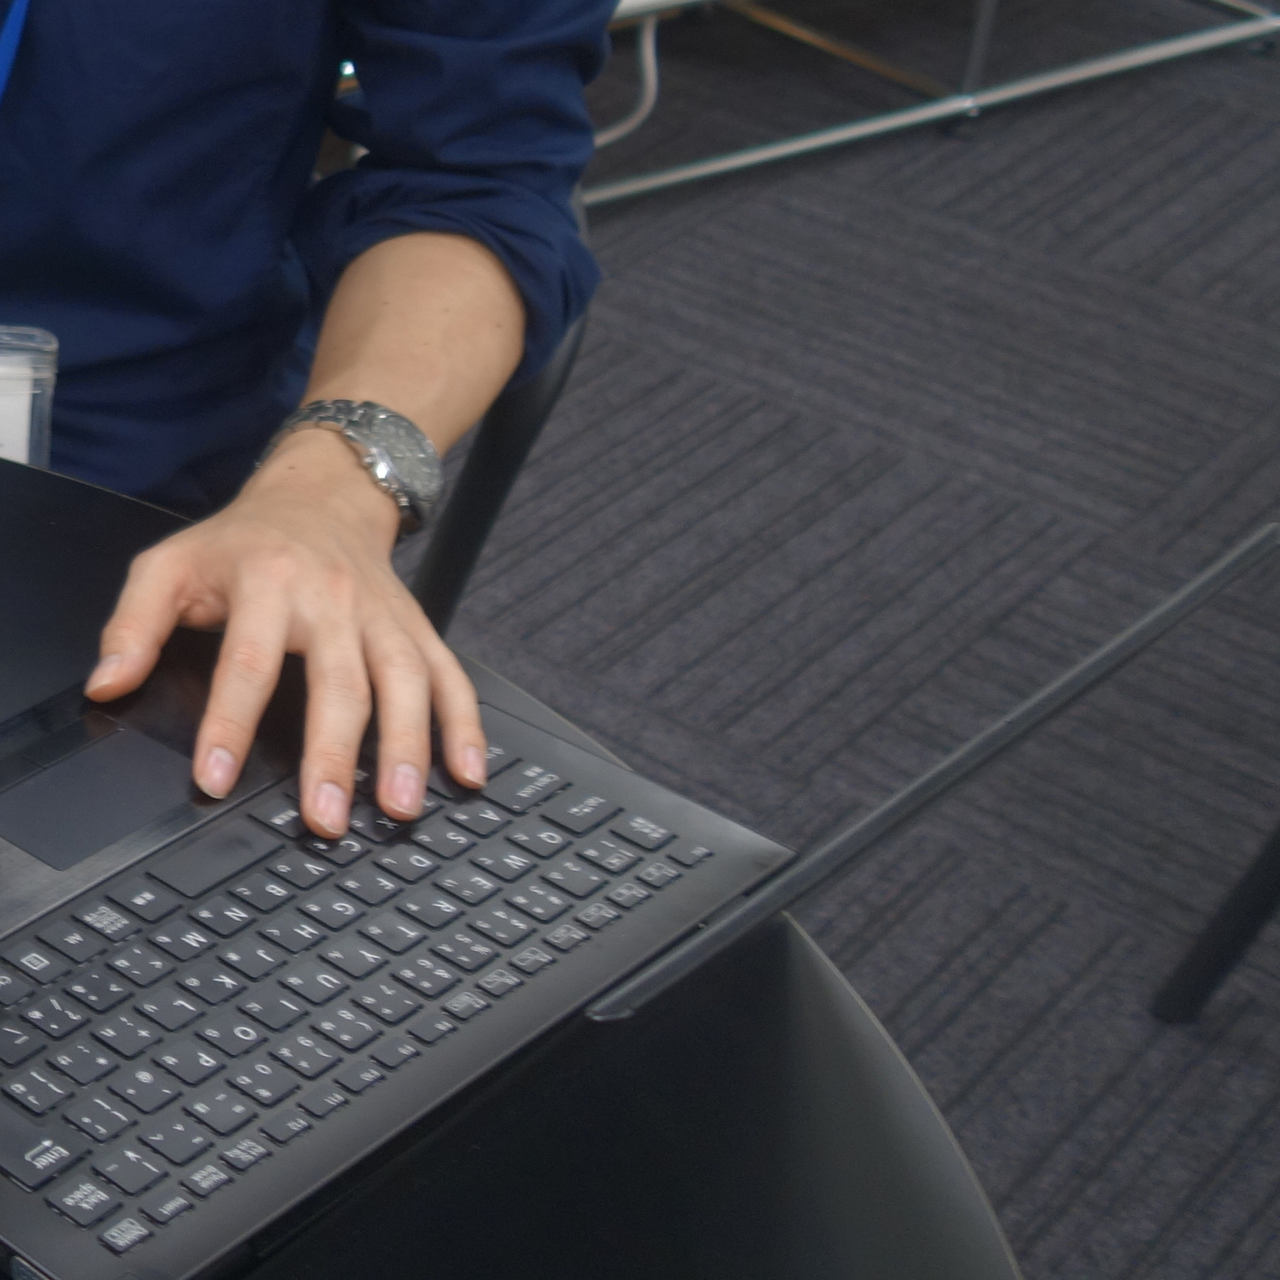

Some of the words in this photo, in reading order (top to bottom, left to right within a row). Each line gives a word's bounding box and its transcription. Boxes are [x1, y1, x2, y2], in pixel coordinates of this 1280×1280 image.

[478, 809, 500, 821] A
[445, 831, 467, 843] S
[537, 831, 562, 843] Q
[339, 839, 361, 851] C
[409, 854, 432, 867] D
[502, 854, 529, 869] W
[303, 862, 325, 875] V
[376, 877, 395, 889] F
[470, 876, 493, 889] E
[265, 883, 287, 896] B
[331, 901, 354, 915] G
[432, 899, 456, 912] R
[223, 907, 248, 921] N
[293, 923, 318, 938] H
[396, 925, 418, 937] T
[63, 932, 83, 944] Alt
[180, 931, 207, 947] M
[256, 948, 274, 962] J
[358, 949, 380, 962] Y
[212, 974, 237, 988] K
[316, 973, 340, 988] U
[172, 999, 195, 1011] L
[233, 1025, 256, 1040] O
[197, 1052, 216, 1066] P
[32, 1145, 69, 1168] Enter
[63, 1182, 97, 1205] space
[77, 1189, 109, 1209] Back
